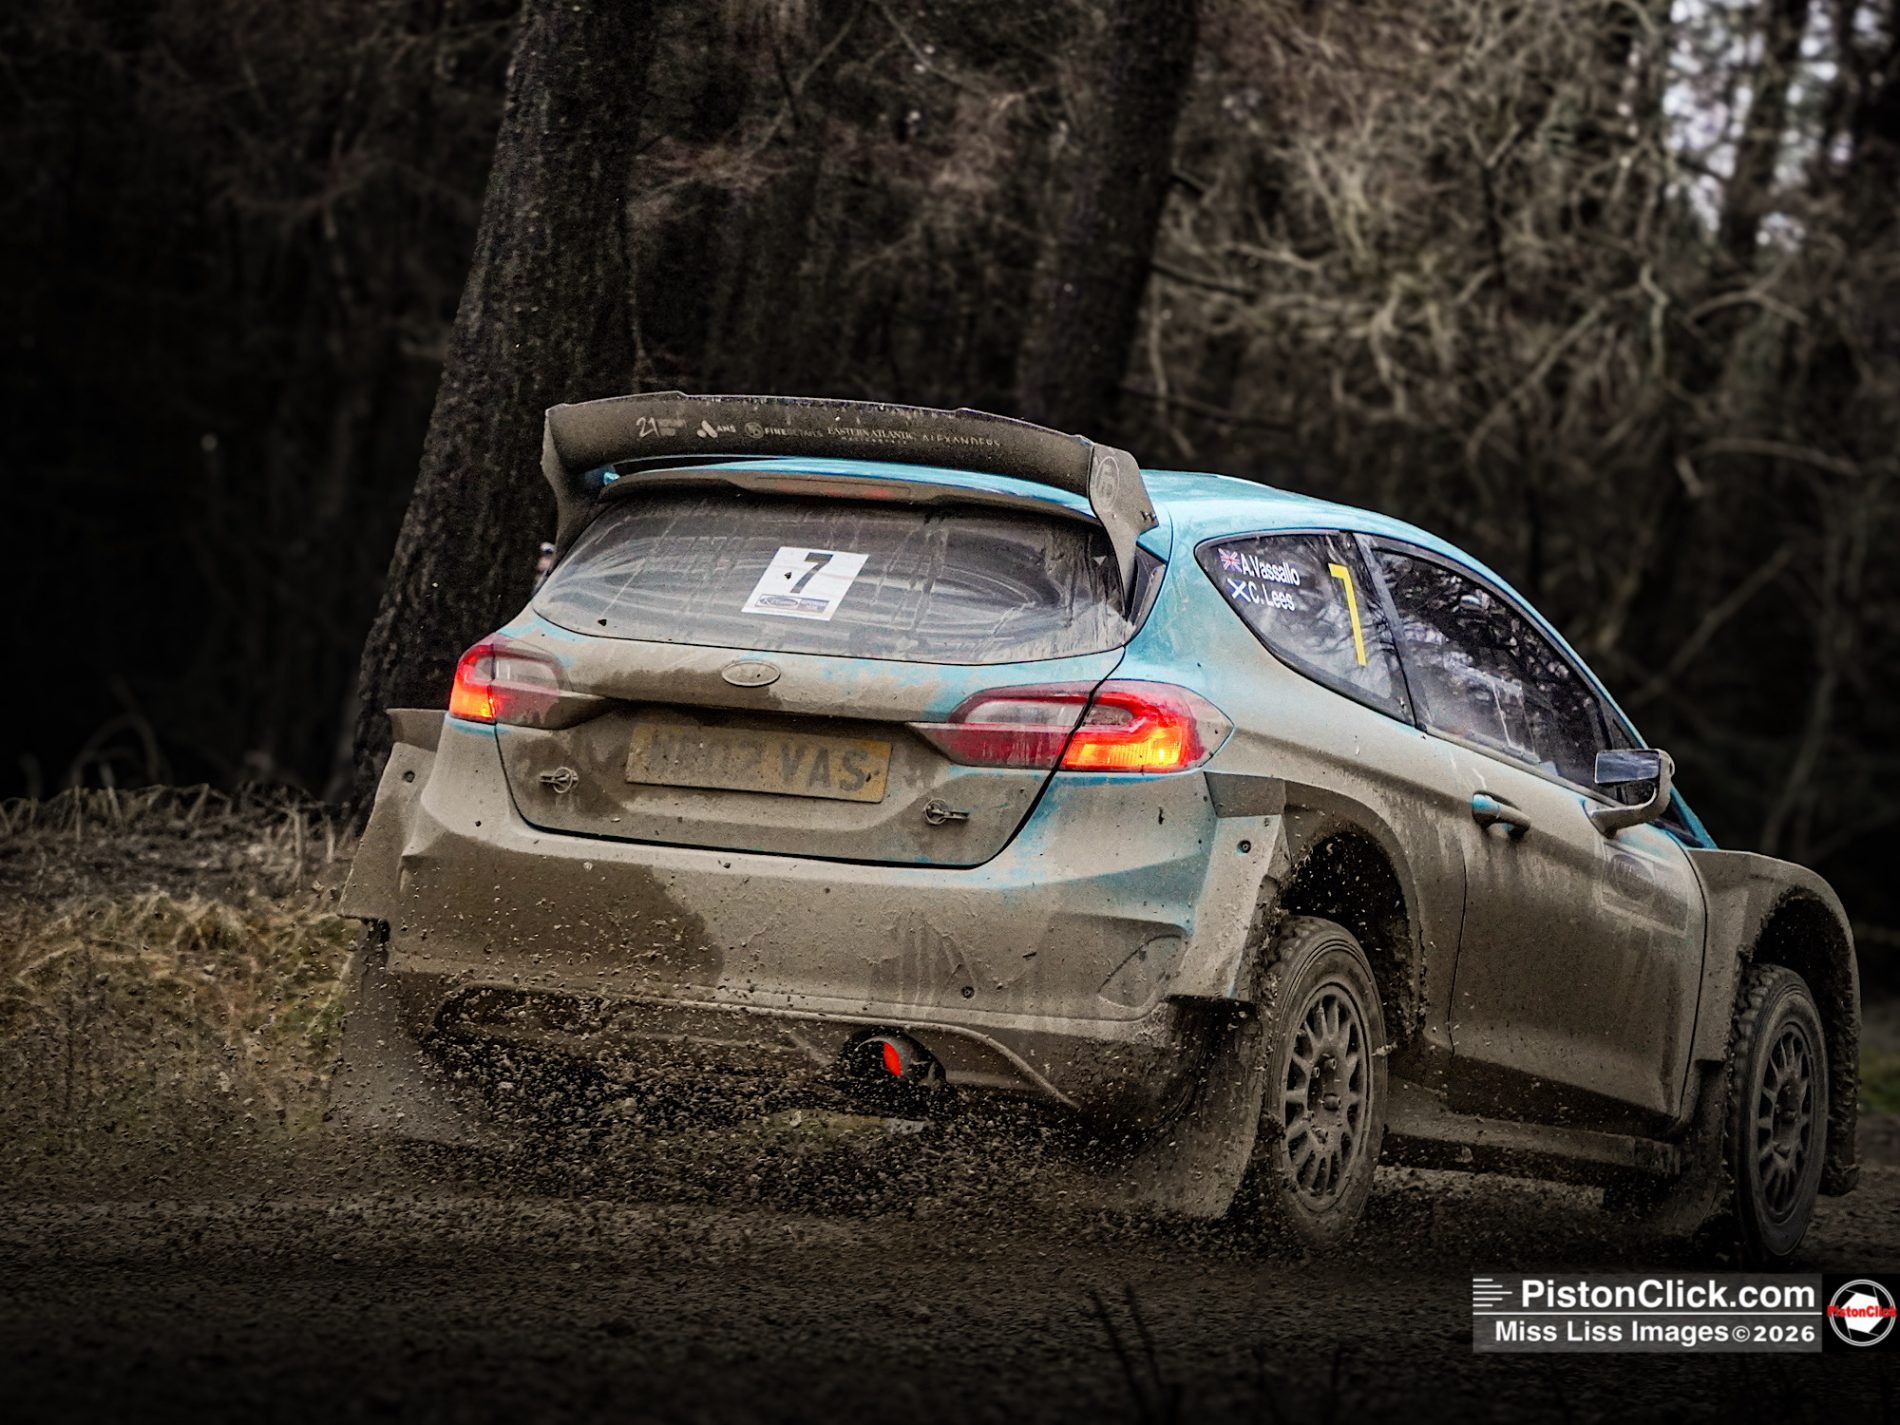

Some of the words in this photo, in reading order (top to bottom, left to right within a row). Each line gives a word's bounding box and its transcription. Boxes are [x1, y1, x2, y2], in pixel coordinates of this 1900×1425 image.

[790, 551, 833, 593] 7
[1328, 563, 1366, 667] 7
[780, 742, 869, 793] VAS
